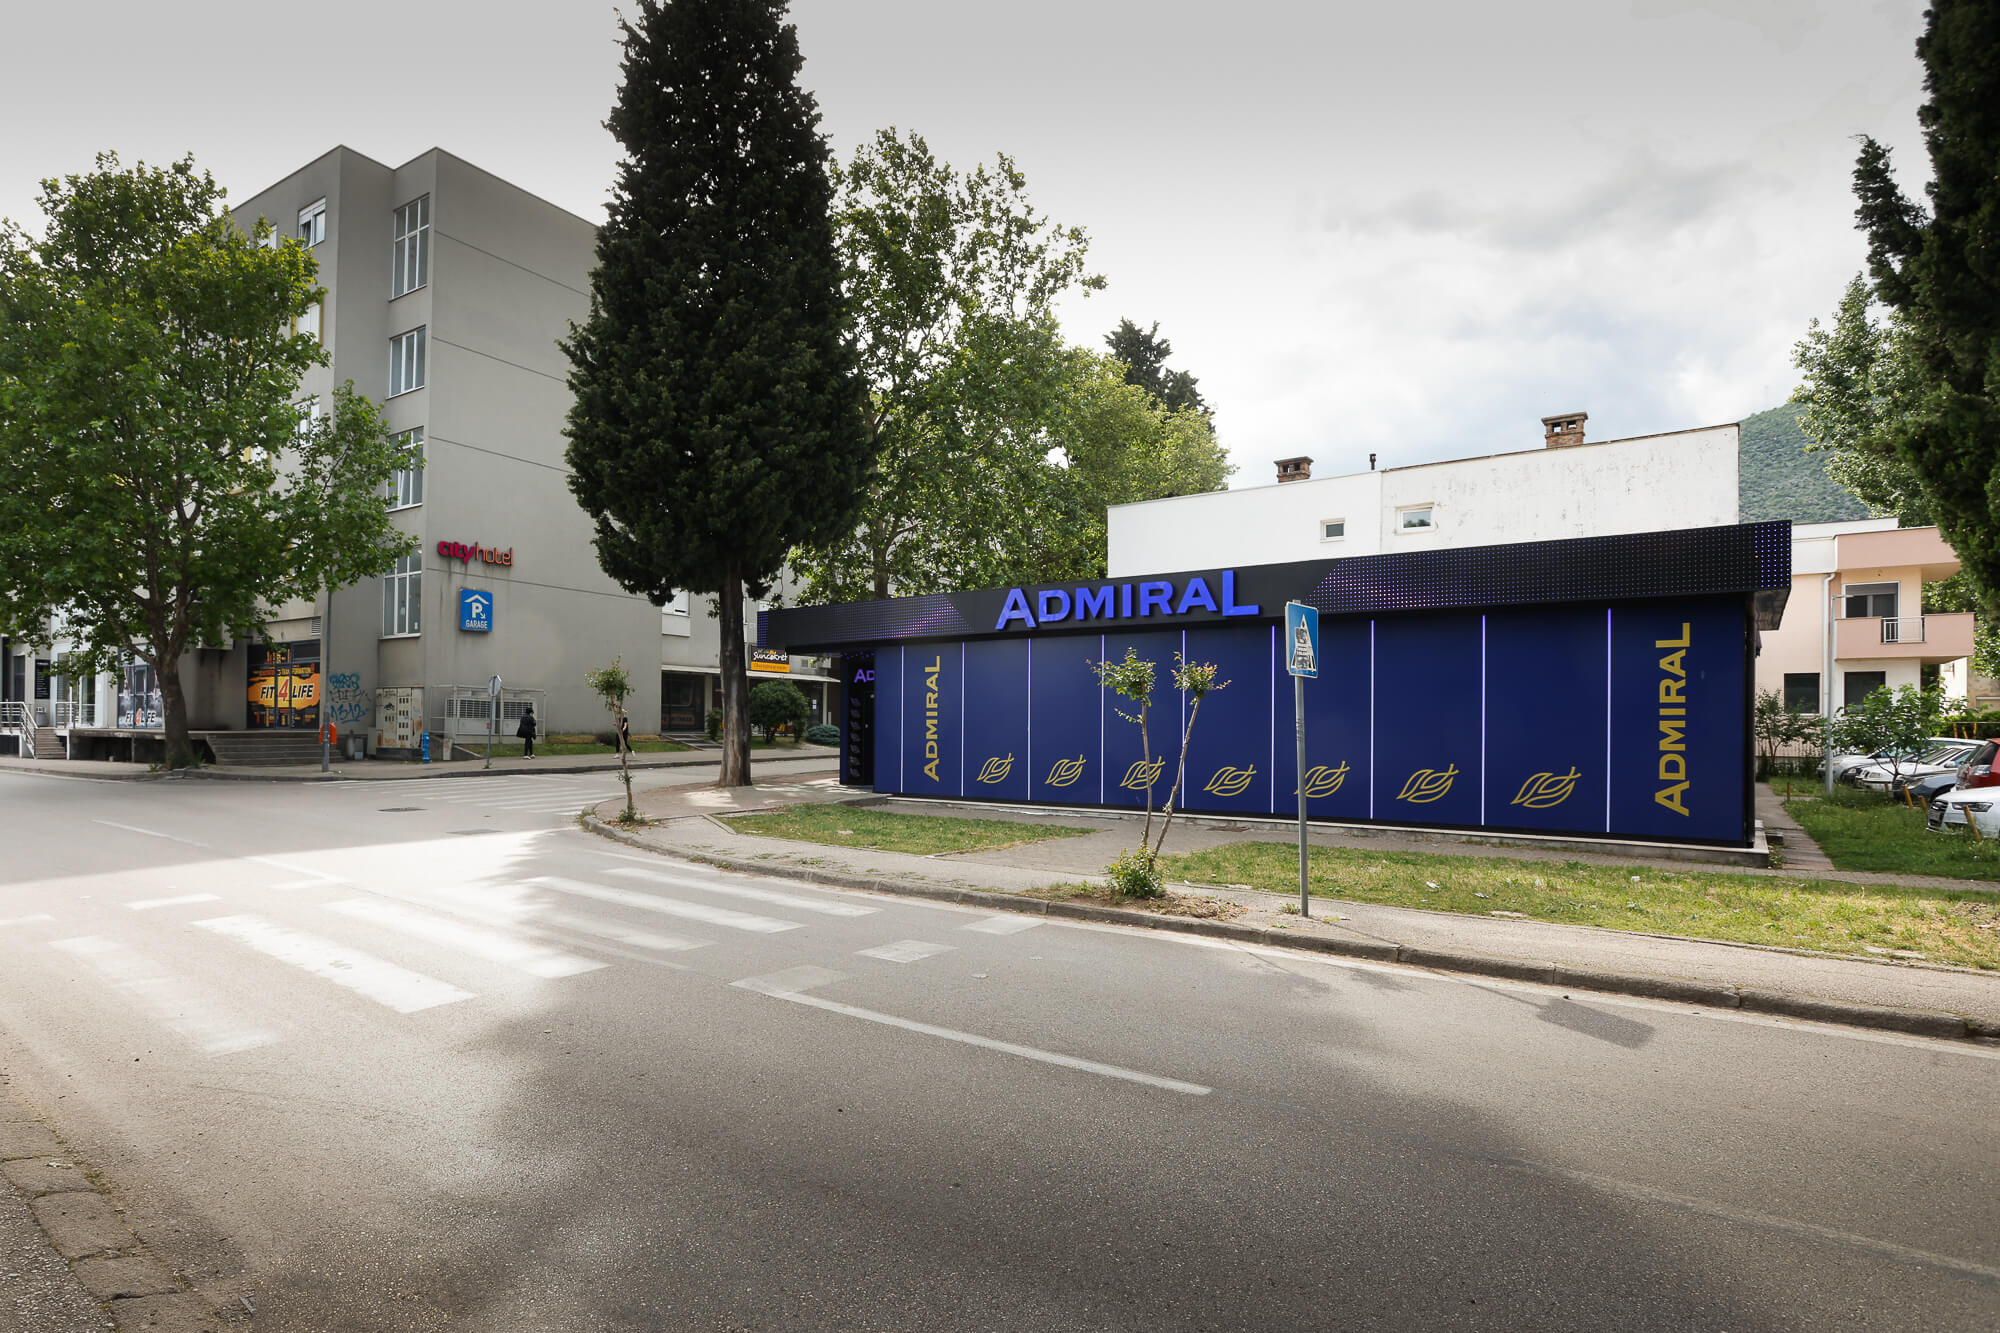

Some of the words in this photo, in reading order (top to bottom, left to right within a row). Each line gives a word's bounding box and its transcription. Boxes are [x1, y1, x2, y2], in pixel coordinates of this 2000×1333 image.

[438, 541, 475, 564] city
[475, 542, 513, 567] hotel
[471, 602, 483, 618] P
[995, 570, 1259, 630] ADMIRAL
[465, 619, 488, 629] GARAGE
[260, 686, 276, 699] FIT
[278, 679, 290, 702] 4
[292, 684, 314, 698] LIFE
[924, 655, 940, 782] ADMIRAL
[1654, 622, 1691, 817] ADMIRAL
